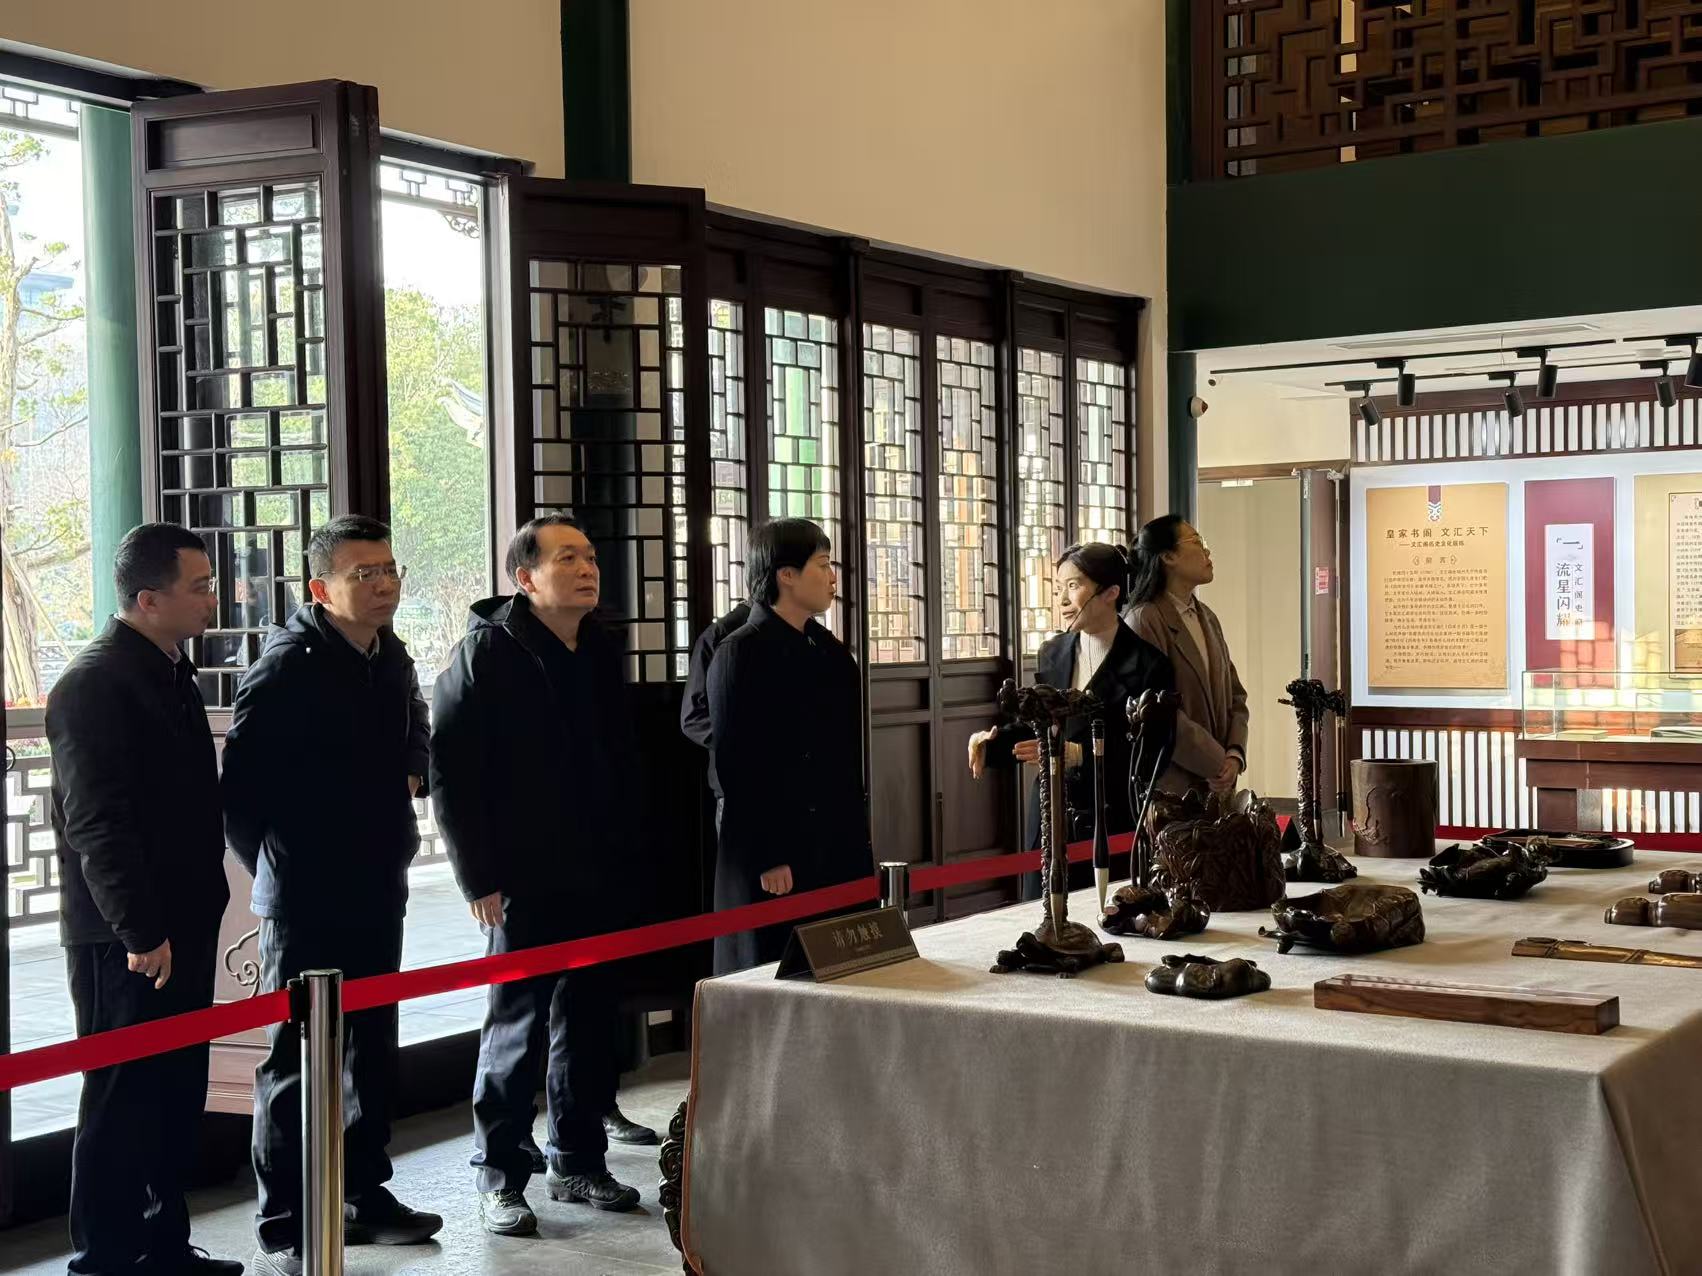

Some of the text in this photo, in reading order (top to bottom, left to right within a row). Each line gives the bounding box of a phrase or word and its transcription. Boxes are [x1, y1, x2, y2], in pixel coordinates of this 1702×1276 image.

[1386, 526, 1489, 539] 皇家书阁 文汇天下
[1556, 562, 1571, 627] 流星闪耀
